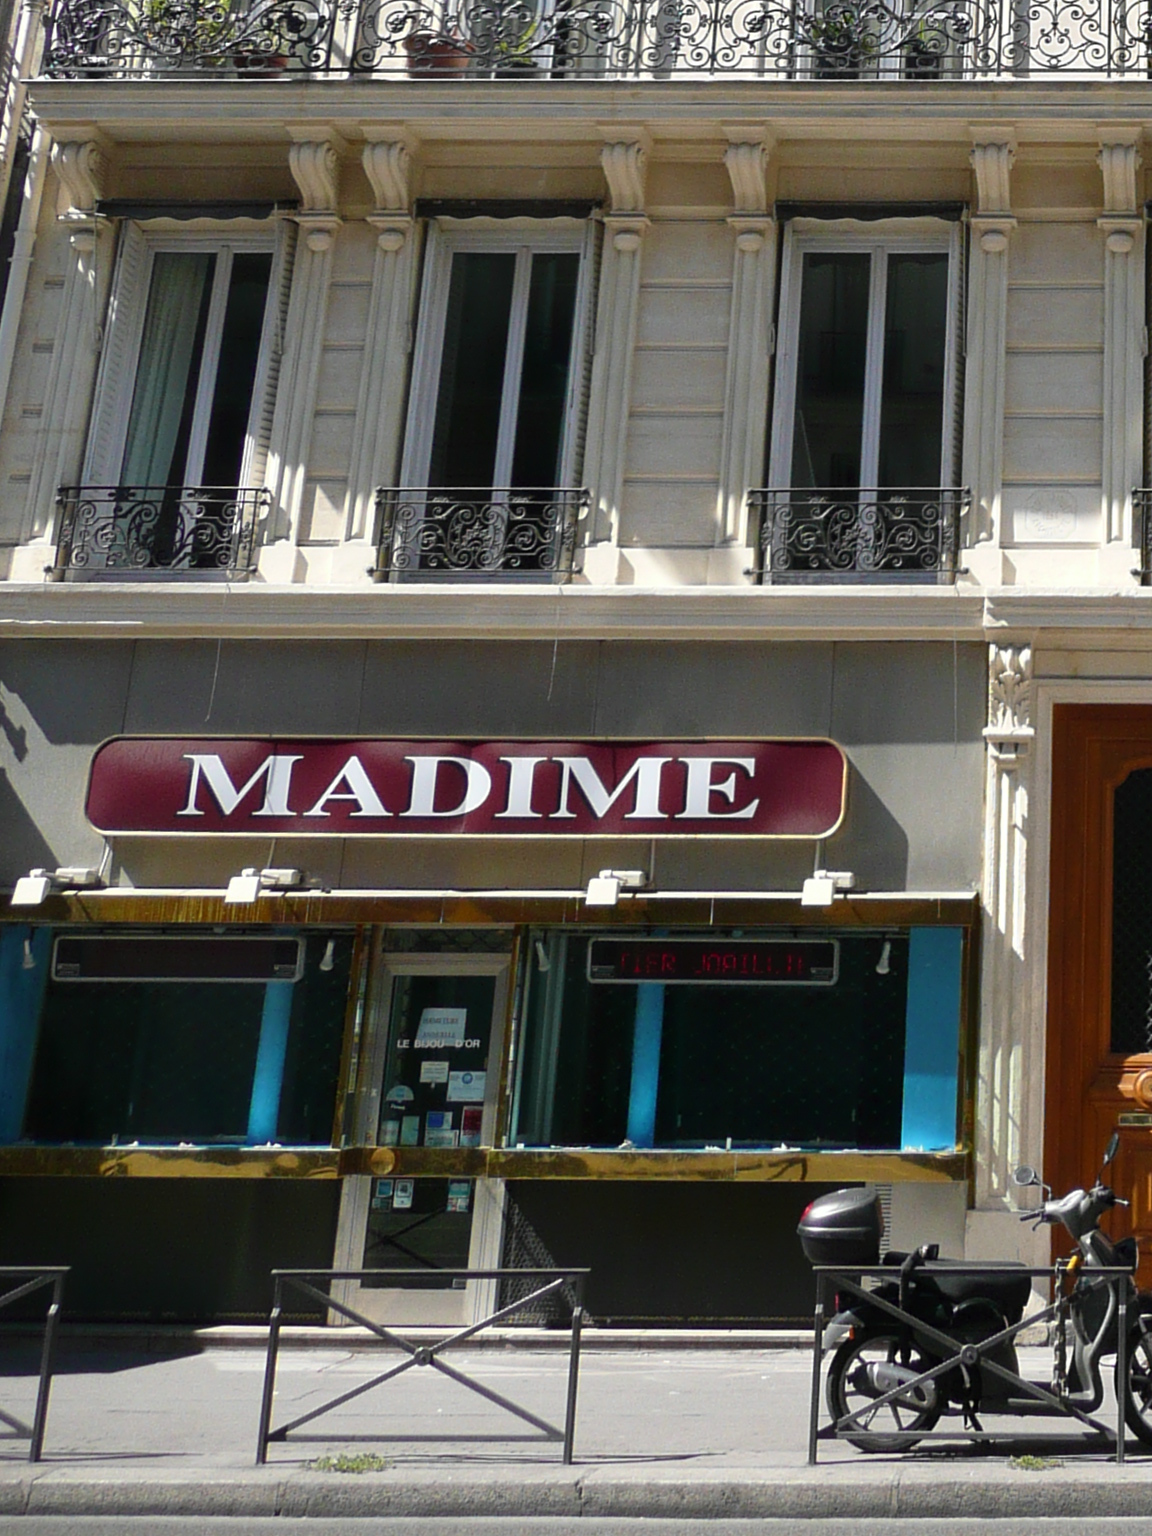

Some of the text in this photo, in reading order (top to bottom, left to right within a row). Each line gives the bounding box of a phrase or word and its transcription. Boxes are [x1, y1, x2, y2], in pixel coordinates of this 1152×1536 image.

[176, 753, 760, 820] MADIME
[397, 1039, 410, 1049] LE
[414, 1039, 445, 1049] BIJOU
